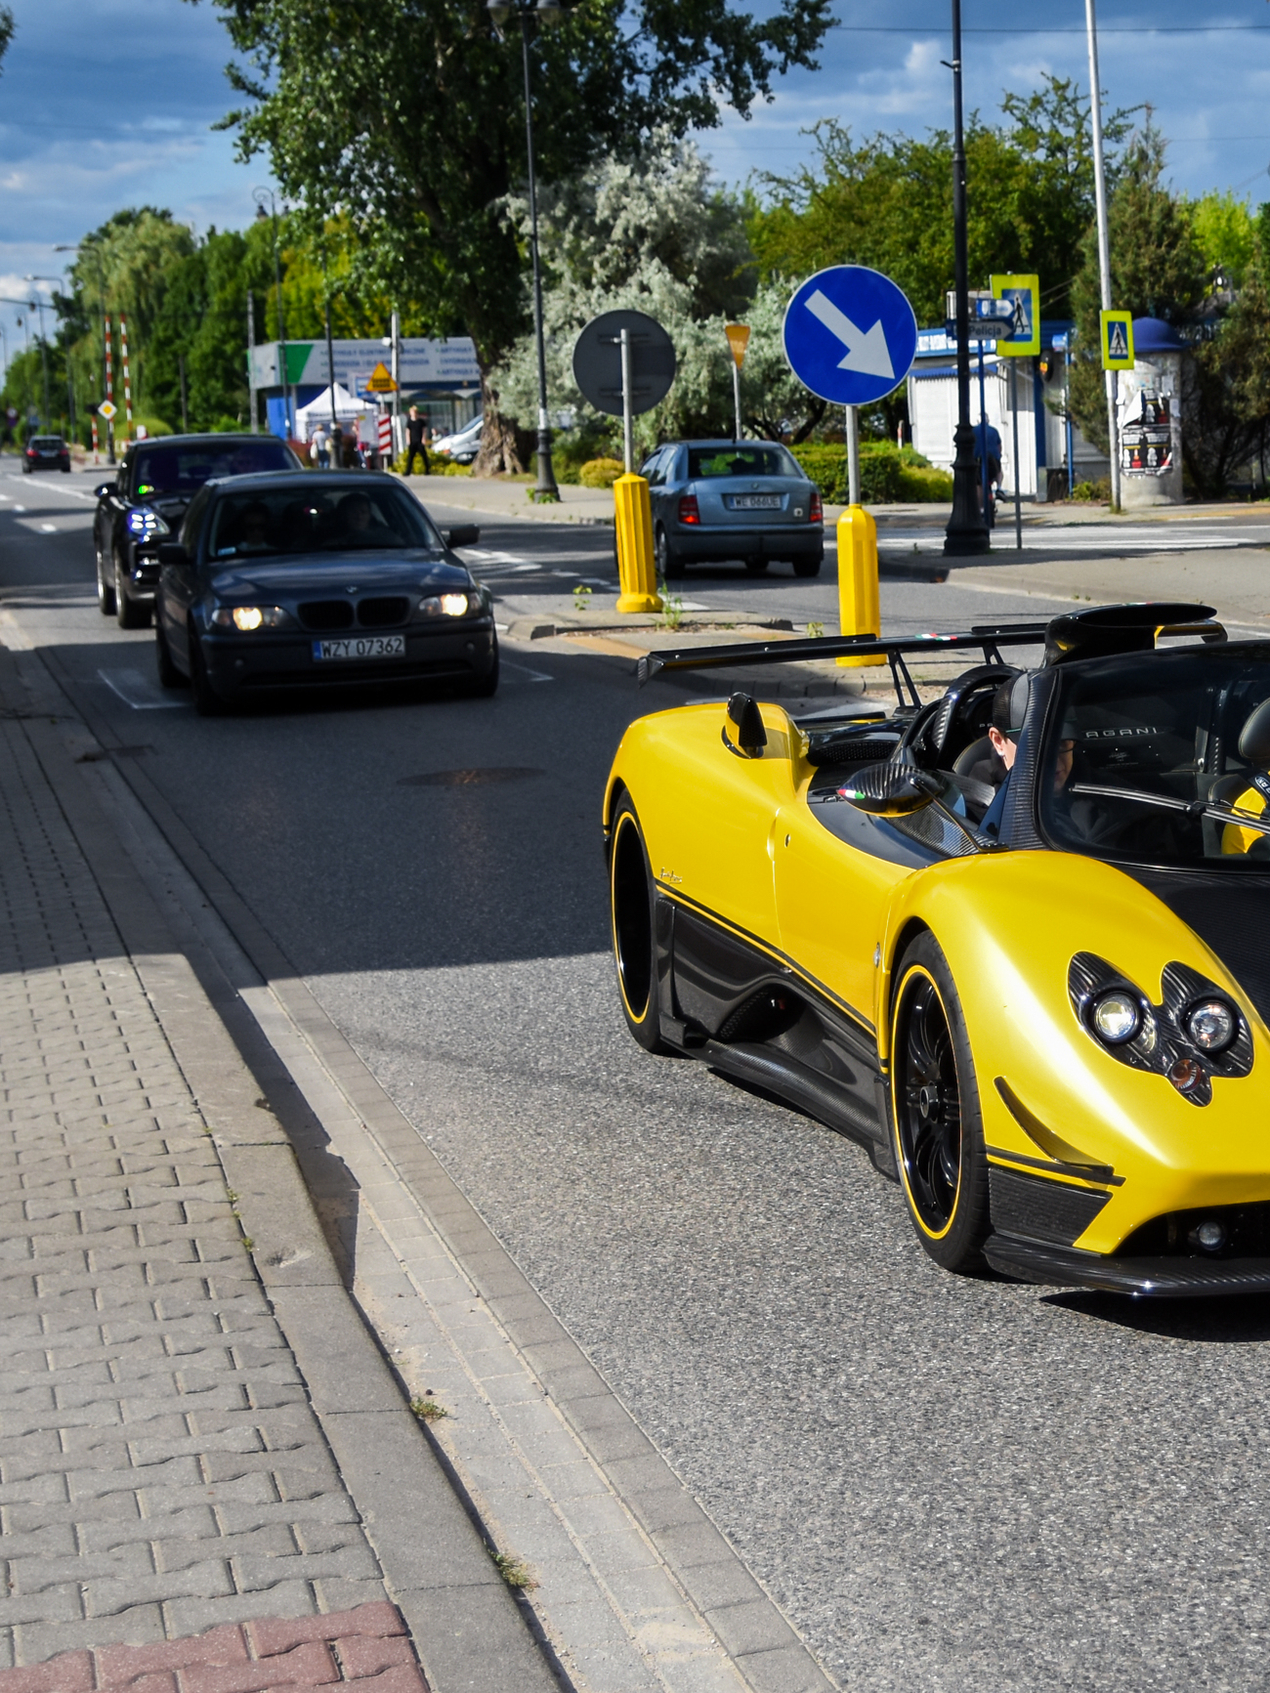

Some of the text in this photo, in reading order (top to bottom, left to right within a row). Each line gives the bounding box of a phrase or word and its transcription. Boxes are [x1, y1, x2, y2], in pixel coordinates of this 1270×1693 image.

[321, 637, 403, 658] WZY 07362
[1085, 727, 1157, 738] AGANI
